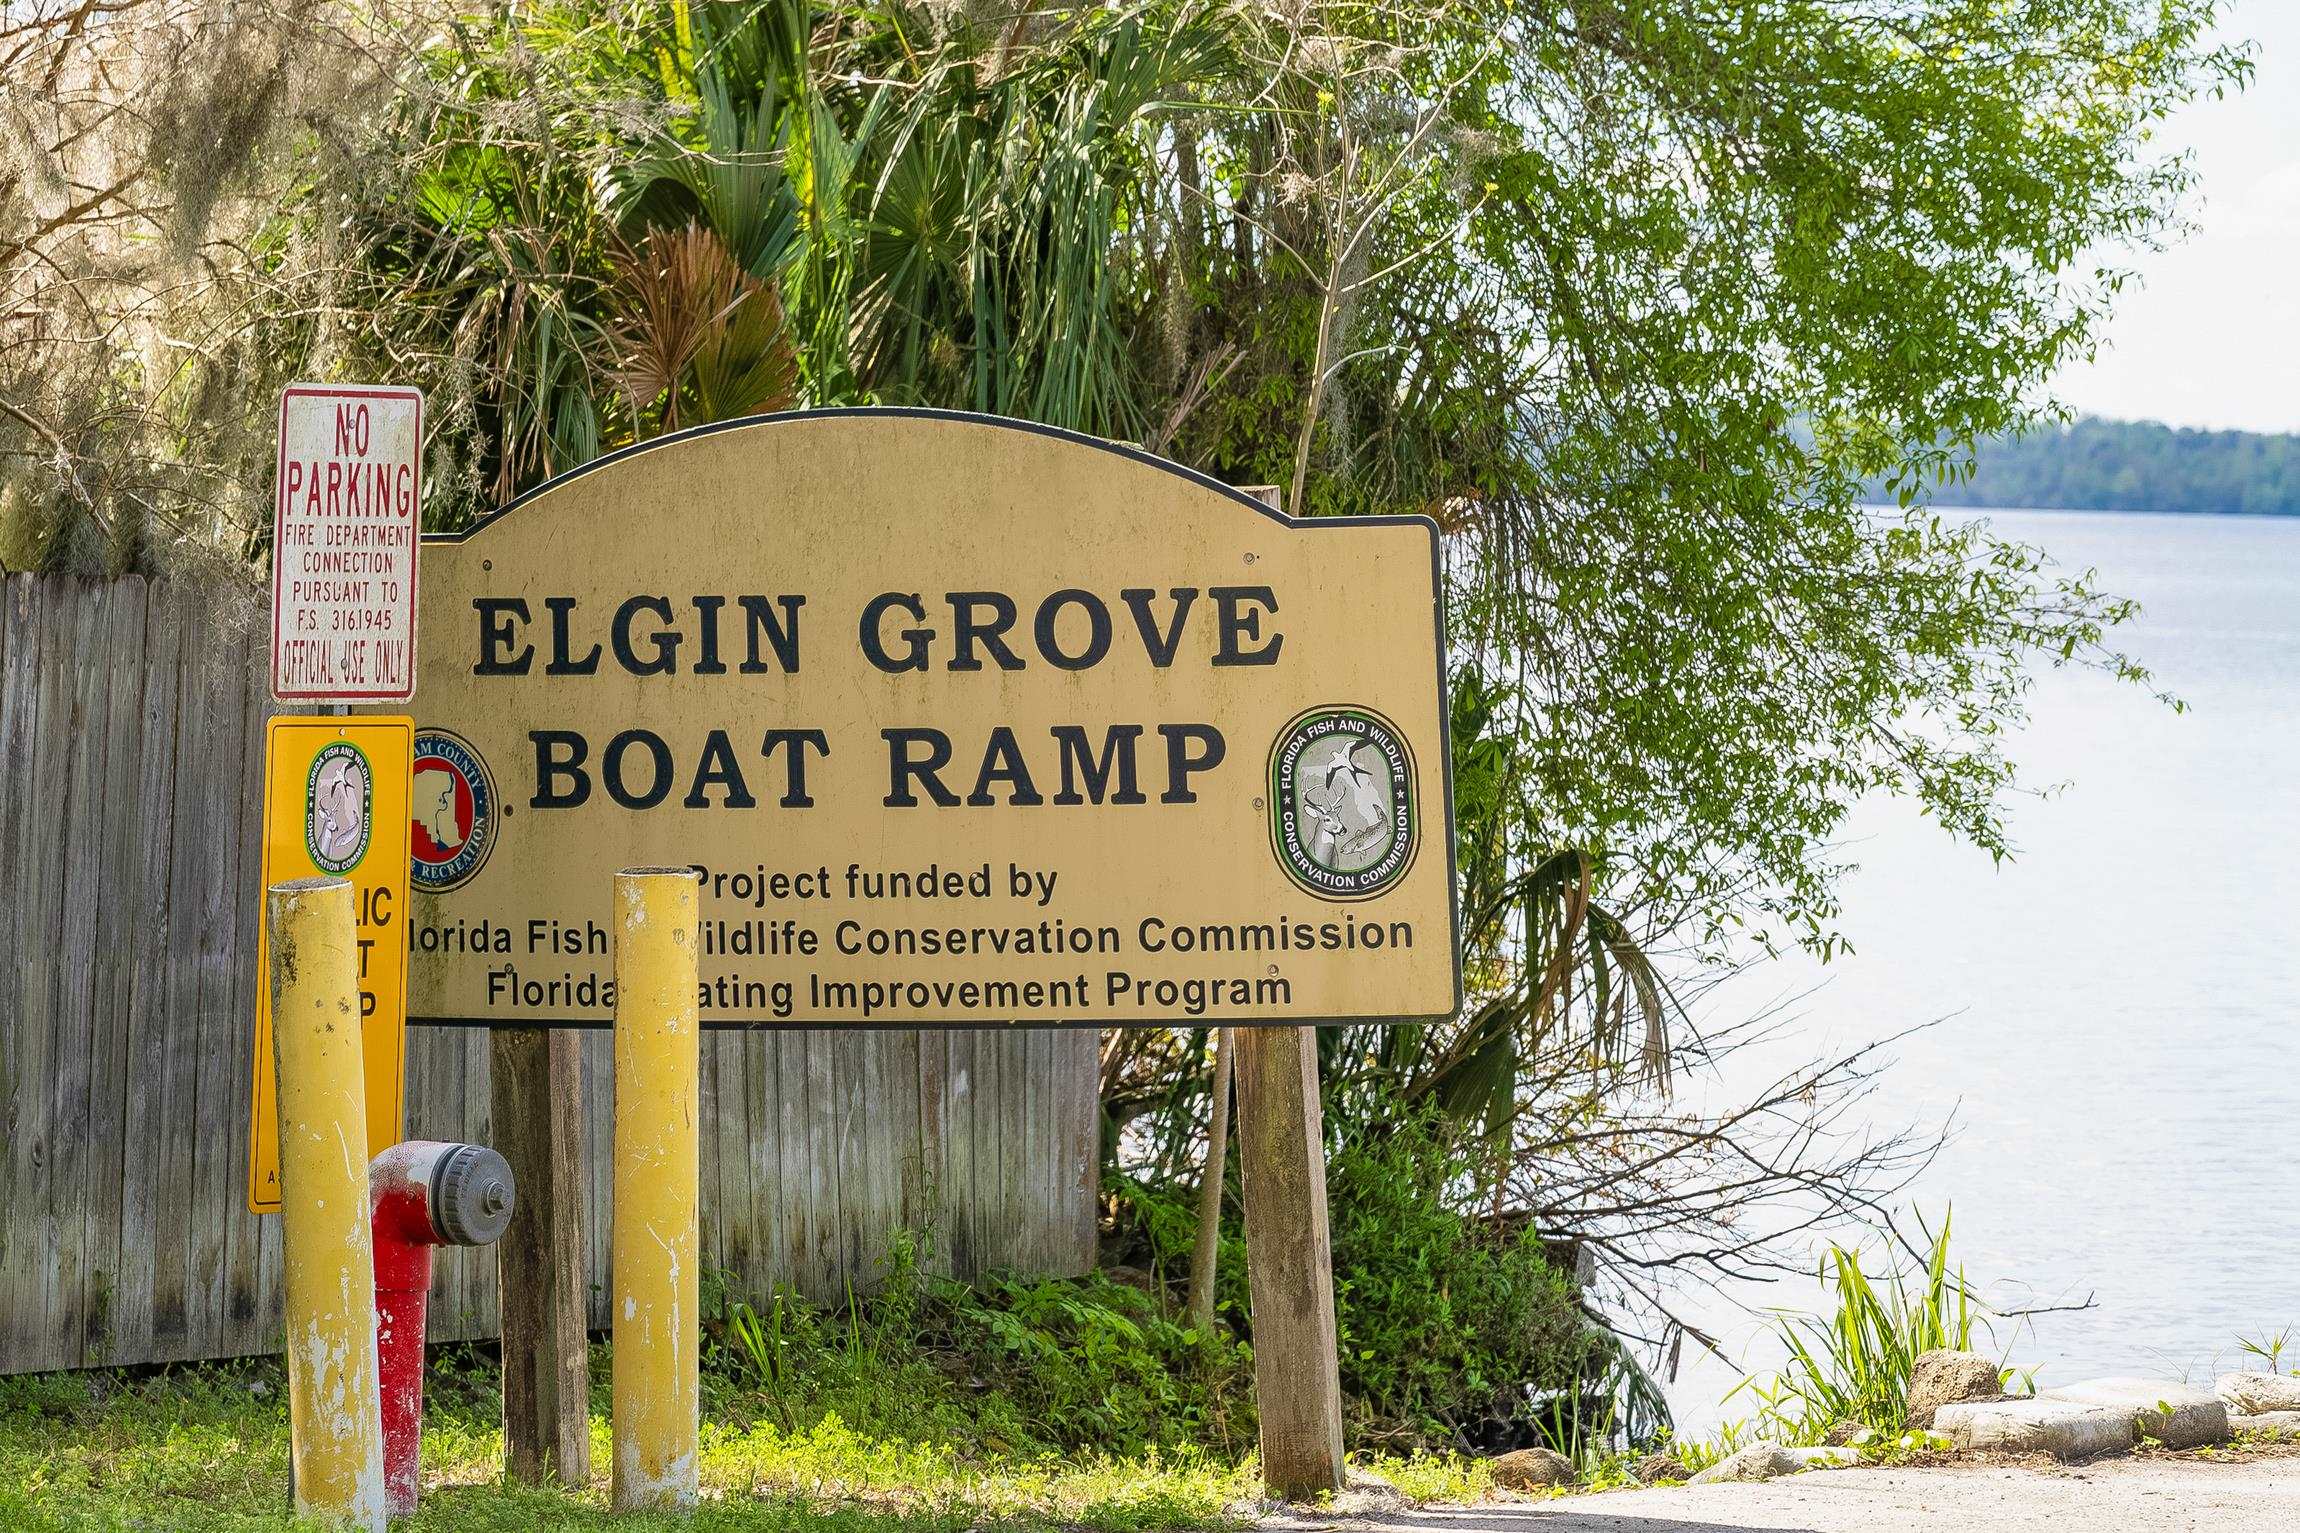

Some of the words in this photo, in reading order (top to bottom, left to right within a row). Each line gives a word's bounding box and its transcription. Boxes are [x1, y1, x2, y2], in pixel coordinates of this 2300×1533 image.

[335, 403, 369, 457] NO
[286, 461, 411, 518] PARKING
[285, 524, 315, 546] FIRE
[326, 525, 411, 548] DEPARTMENT
[303, 551, 393, 574] CONNECTION
[293, 581, 369, 603] PURSUANT
[382, 582, 398, 603] TO
[297, 609, 319, 631] F.S.
[332, 609, 392, 631] 316.1945
[472, 594, 807, 677] ELGIN
[859, 585, 1285, 674] GROVE
[284, 640, 333, 684] OFFICIAL
[344, 640, 366, 684] USE
[375, 640, 404, 684] ONLY
[308, 757, 325, 797] FLORIDA
[323, 746, 339, 761] FISH
[340, 746, 354, 758] AND
[354, 752, 371, 796] WILDLIFE
[436, 743, 484, 788] COUNTY
[528, 728, 832, 810] BOAT
[880, 723, 1227, 807] RAMP
[1280, 734, 1308, 790] FLORIDA
[1306, 719, 1336, 740] FISH
[1338, 719, 1366, 734] AND
[1368, 725, 1405, 783] WILDLIFE
[307, 812, 340, 872] CONSERVATION
[341, 812, 371, 871] COMMISSION
[420, 816, 486, 879] RECREATION
[1282, 811, 1356, 888] CONSERVATION
[1359, 804, 1408, 886] COMMISSION
[686, 864, 831, 908] Project
[846, 863, 991, 898] funded
[1009, 862, 1058, 906] by
[409, 918, 512, 953] lorida
[528, 920, 608, 954] Fish
[698, 920, 819, 955] ildlife
[835, 918, 1120, 955] Conservation
[1138, 914, 1413, 952] Commission
[488, 972, 614, 1008] Florida
[698, 974, 792, 1018] ating
[811, 971, 1090, 1017] Improvement
[1106, 971, 1291, 1015] Program
